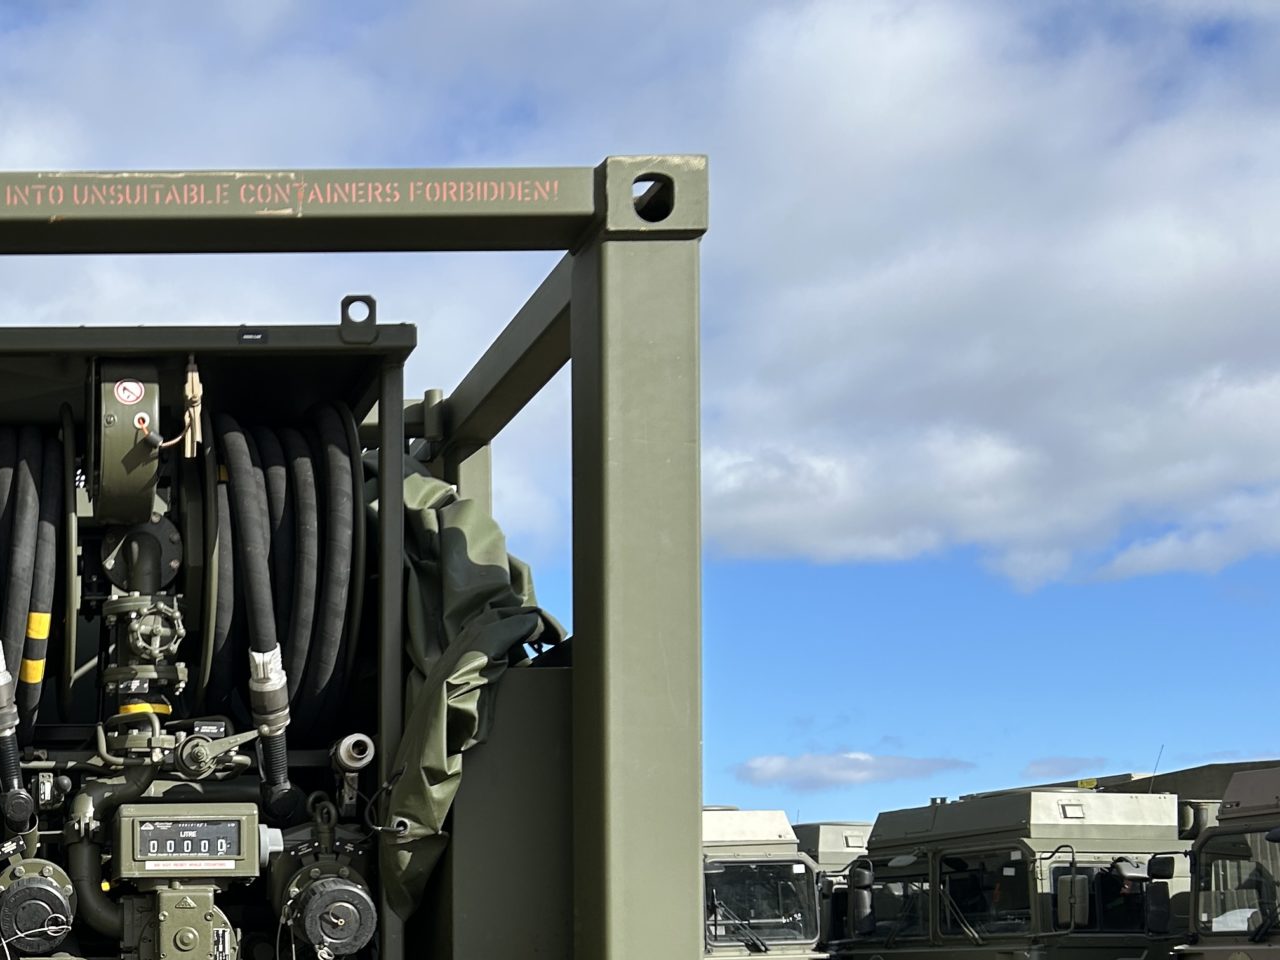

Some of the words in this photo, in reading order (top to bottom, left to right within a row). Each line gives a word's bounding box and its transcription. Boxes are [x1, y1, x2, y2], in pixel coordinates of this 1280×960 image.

[6, 183, 64, 206] INTO
[73, 182, 230, 206] UNSUITABLE
[239, 180, 401, 205] CONTAINERS
[409, 180, 560, 204] FORBIDDEN!
[180, 830, 197, 838] LITRE
